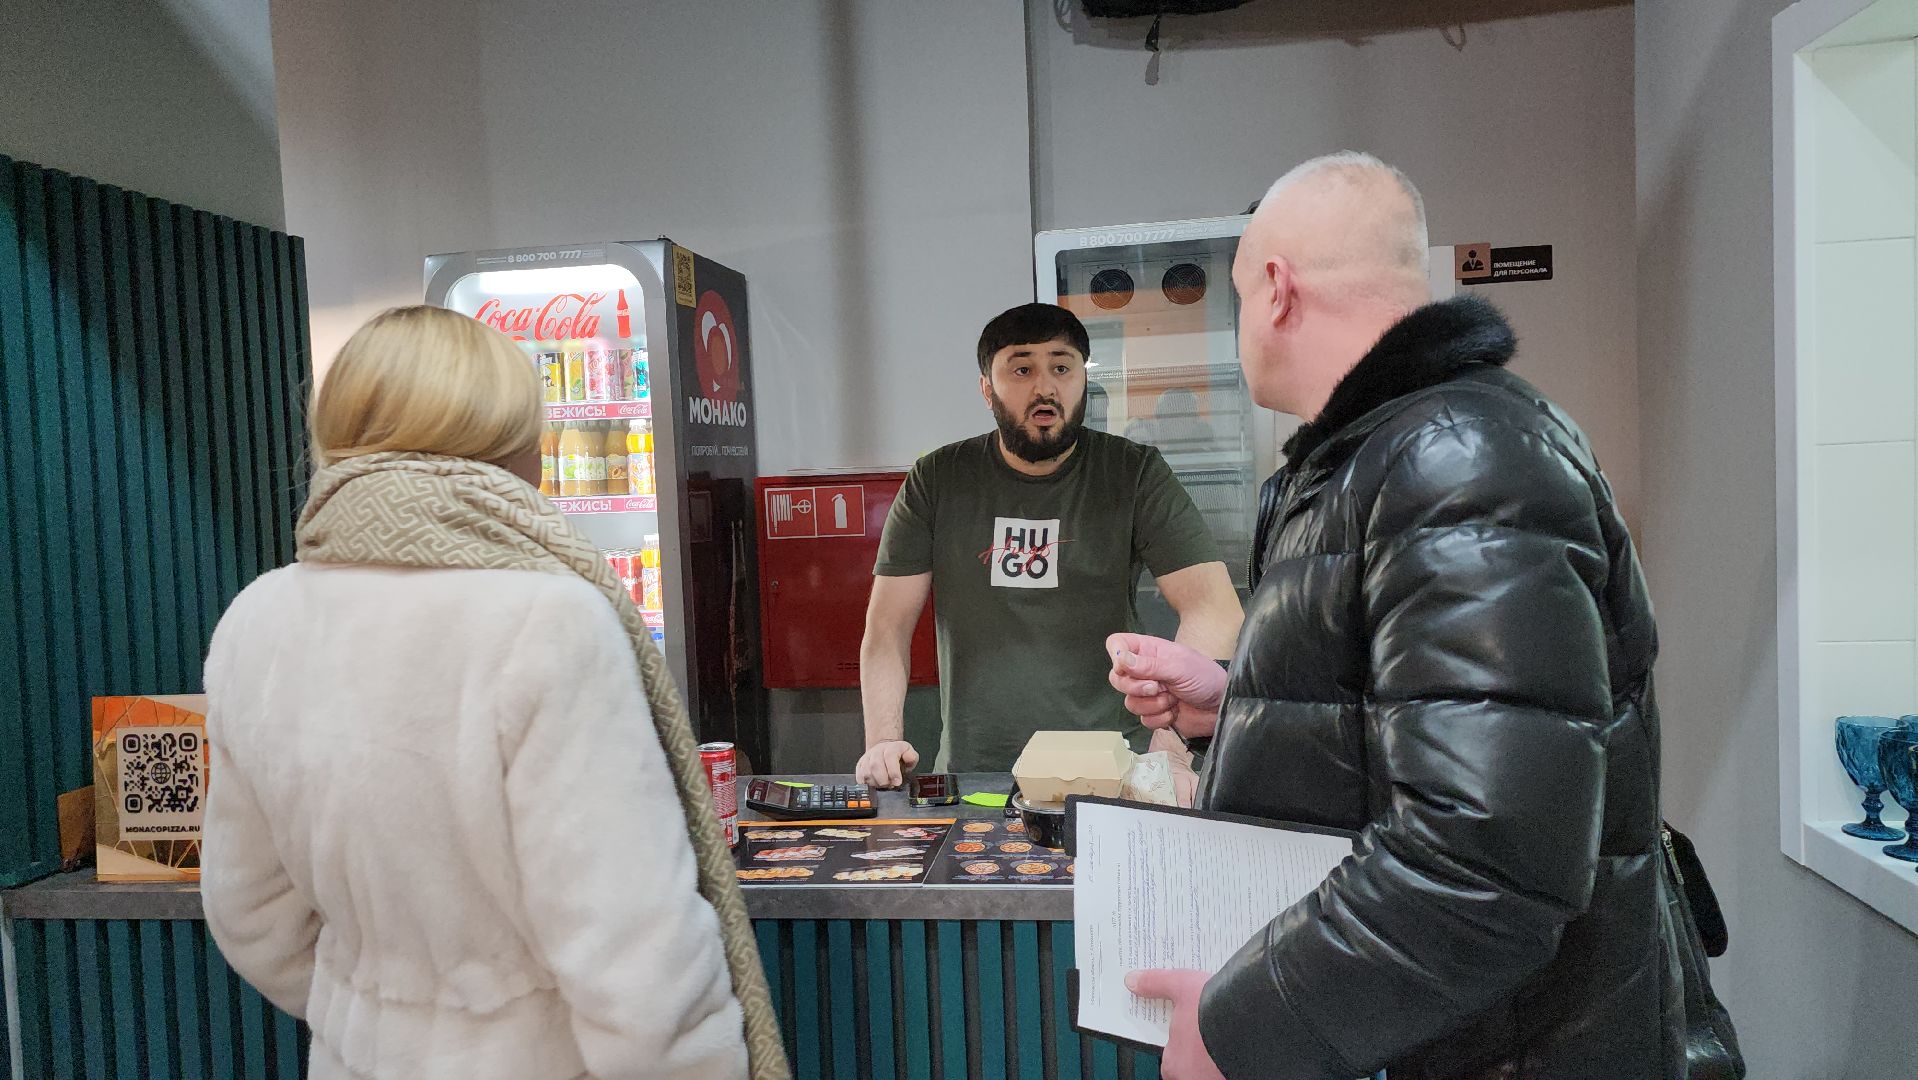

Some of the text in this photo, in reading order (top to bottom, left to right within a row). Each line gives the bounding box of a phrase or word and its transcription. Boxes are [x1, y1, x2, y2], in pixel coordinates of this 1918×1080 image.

[1080, 235, 1088, 247] 8
[1089, 233, 1116, 246] 800
[1119, 231, 1143, 244] 700
[1144, 229, 1175, 242] 7777
[508, 254, 515, 263] 8
[516, 253, 536, 262] 800
[537, 252, 557, 261] 700
[559, 250, 582, 259] 7777
[1494, 259, 1536, 269] ПОМЕЩЕНИЕ
[1494, 267, 1548, 278] ДЛЯ ПЕРСОНАЛА
[688, 396, 747, 428] МОНАКО
[125, 824, 201, 834] MONACOPIZZA.RU
